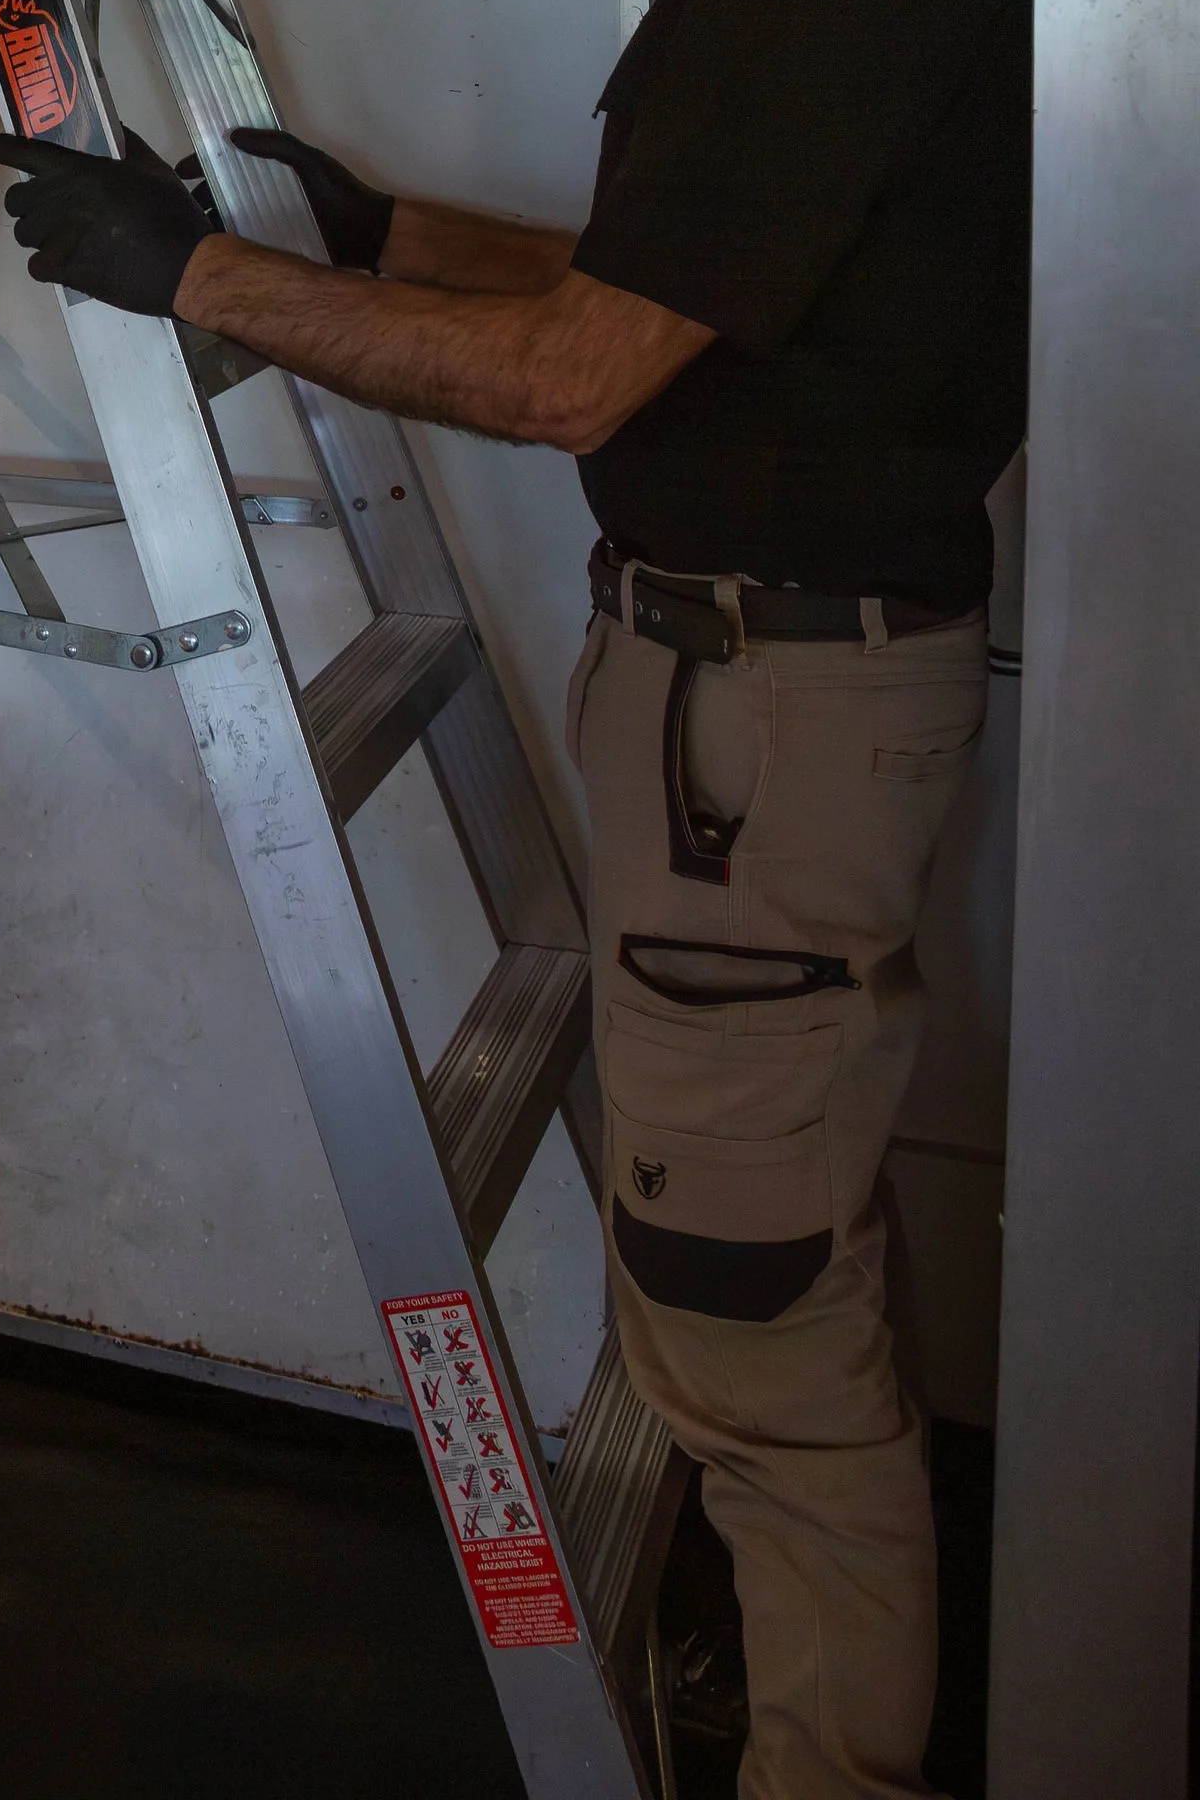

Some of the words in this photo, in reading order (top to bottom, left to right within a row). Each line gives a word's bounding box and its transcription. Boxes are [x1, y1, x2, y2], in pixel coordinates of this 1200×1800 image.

[4, 25, 66, 135] RHINO
[387, 1300, 404, 1310] FOR
[406, 1296, 430, 1308] YOUR
[431, 1291, 463, 1304] SAFETY
[401, 1312, 425, 1326] YES
[441, 1309, 459, 1320] NO
[462, 1544, 476, 1552] DO
[477, 1542, 495, 1551] NOT
[515, 1537, 547, 1548] WHERE
[481, 1550, 534, 1561] ELECTRICAL
[477, 1561, 518, 1571] HAZARDS
